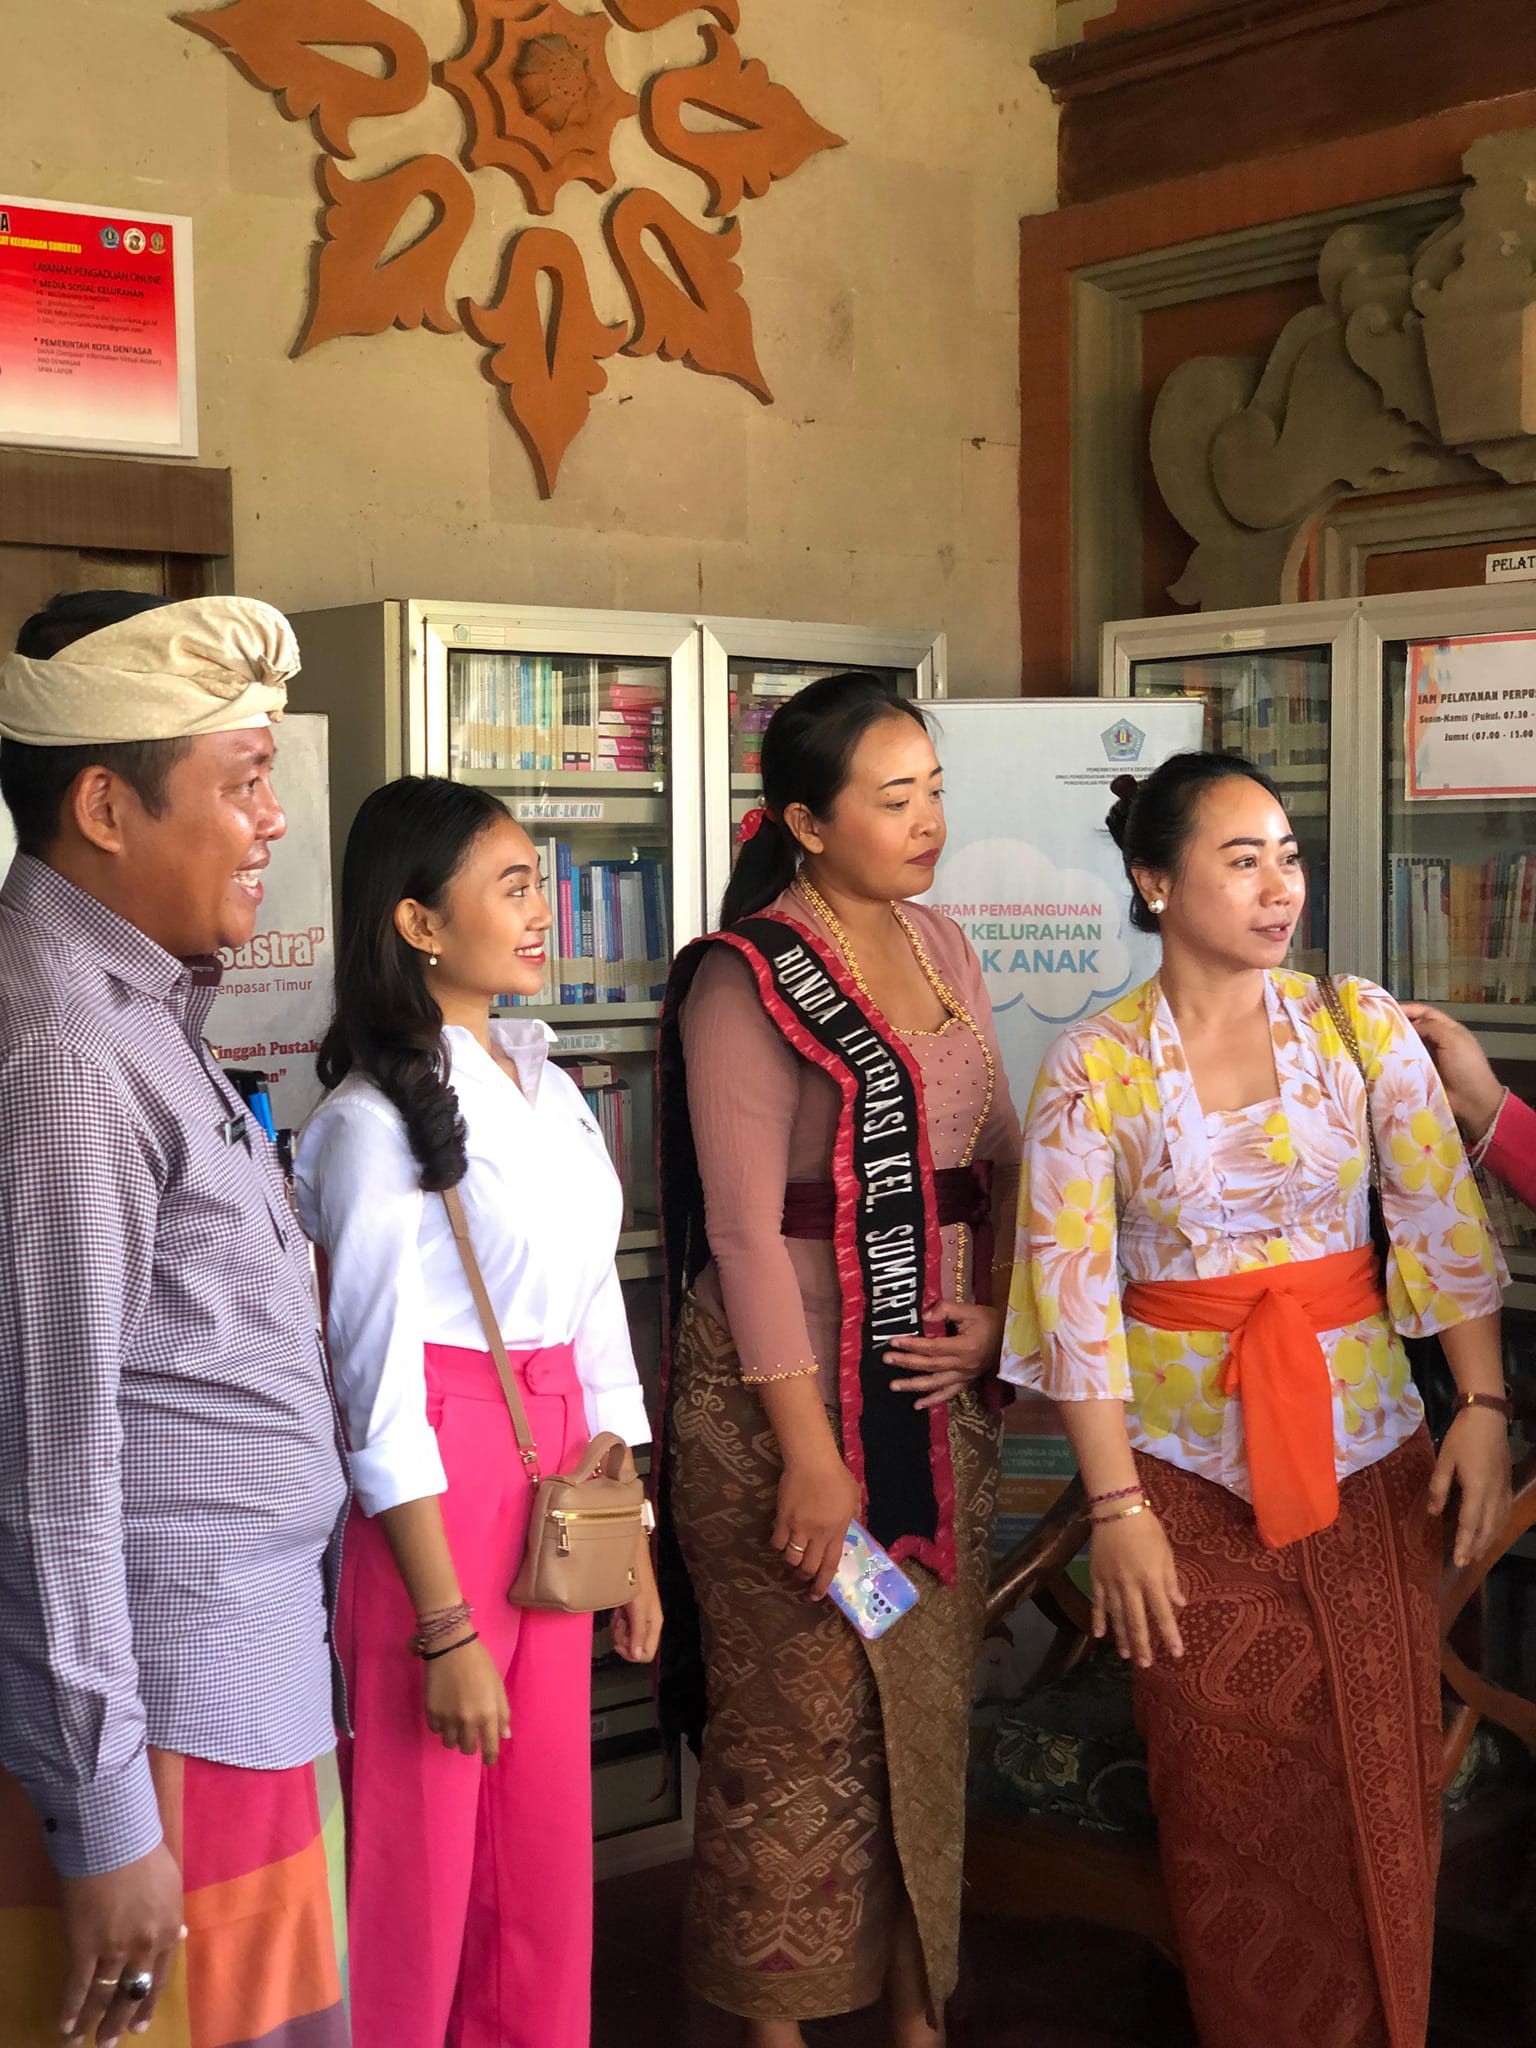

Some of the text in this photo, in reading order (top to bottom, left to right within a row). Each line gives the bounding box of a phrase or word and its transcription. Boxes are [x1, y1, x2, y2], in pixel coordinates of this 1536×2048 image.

[40, 280, 66, 289] MEDIA
[68, 283, 95, 292] SOSIAL
[40, 338, 90, 349] PEMERINTAH
[92, 343, 111, 352] KOTA
[1417, 688, 1536, 705] JAM PELAYANAN PERPU
[923, 903, 1102, 917] GRAM PEMBANGUNAN
[971, 923, 1102, 941] KELURAHAN
[1008, 949, 1099, 974] ANAK
[217, 979, 312, 996] enpasar Timur
[773, 943, 849, 1025] BUNDA
[269, 1040, 321, 1056] Pustak
[835, 1025, 908, 1144] LITERASI
[863, 1151, 912, 1213] KEL.
